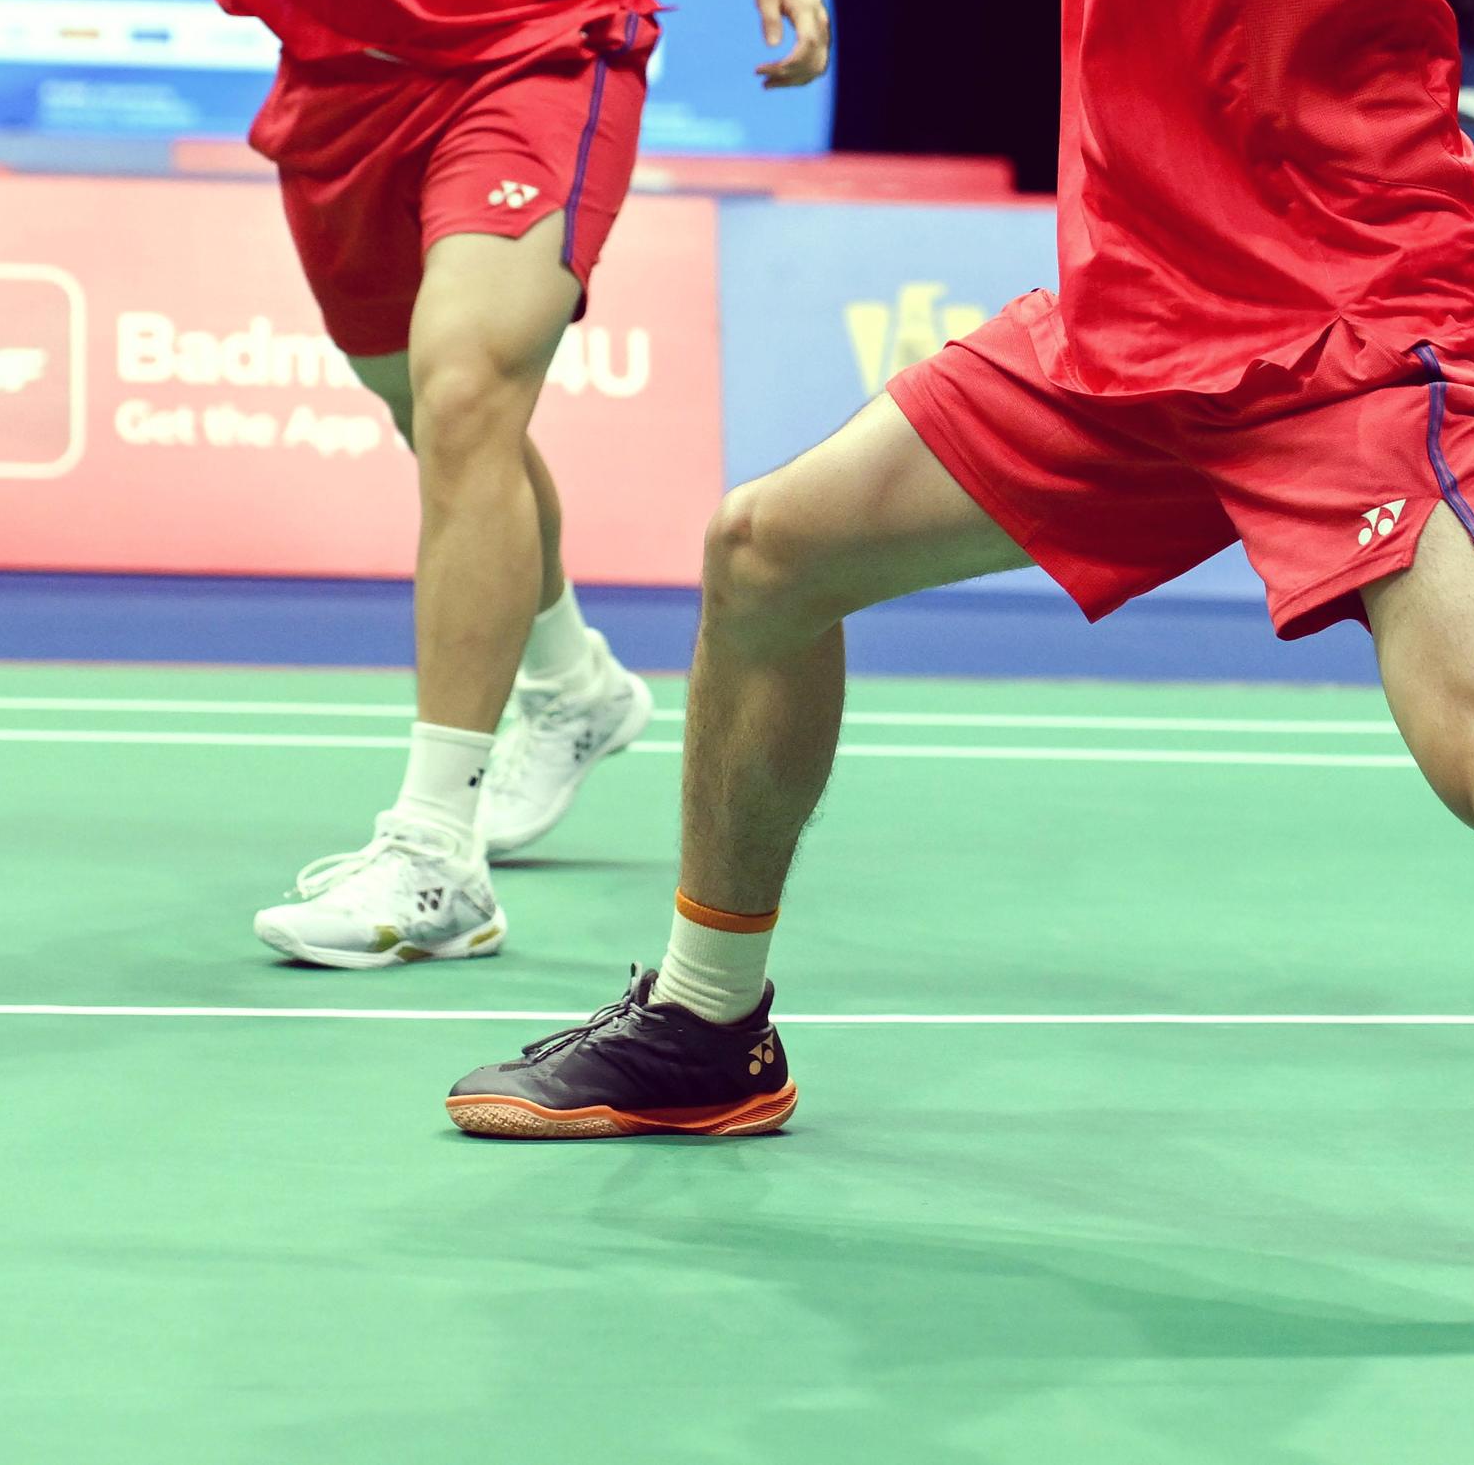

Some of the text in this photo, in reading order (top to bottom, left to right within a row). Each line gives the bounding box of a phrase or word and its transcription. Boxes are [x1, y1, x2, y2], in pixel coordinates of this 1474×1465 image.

[115, 399, 195, 445] Get
[203, 403, 276, 446] the
[282, 405, 381, 457] App
